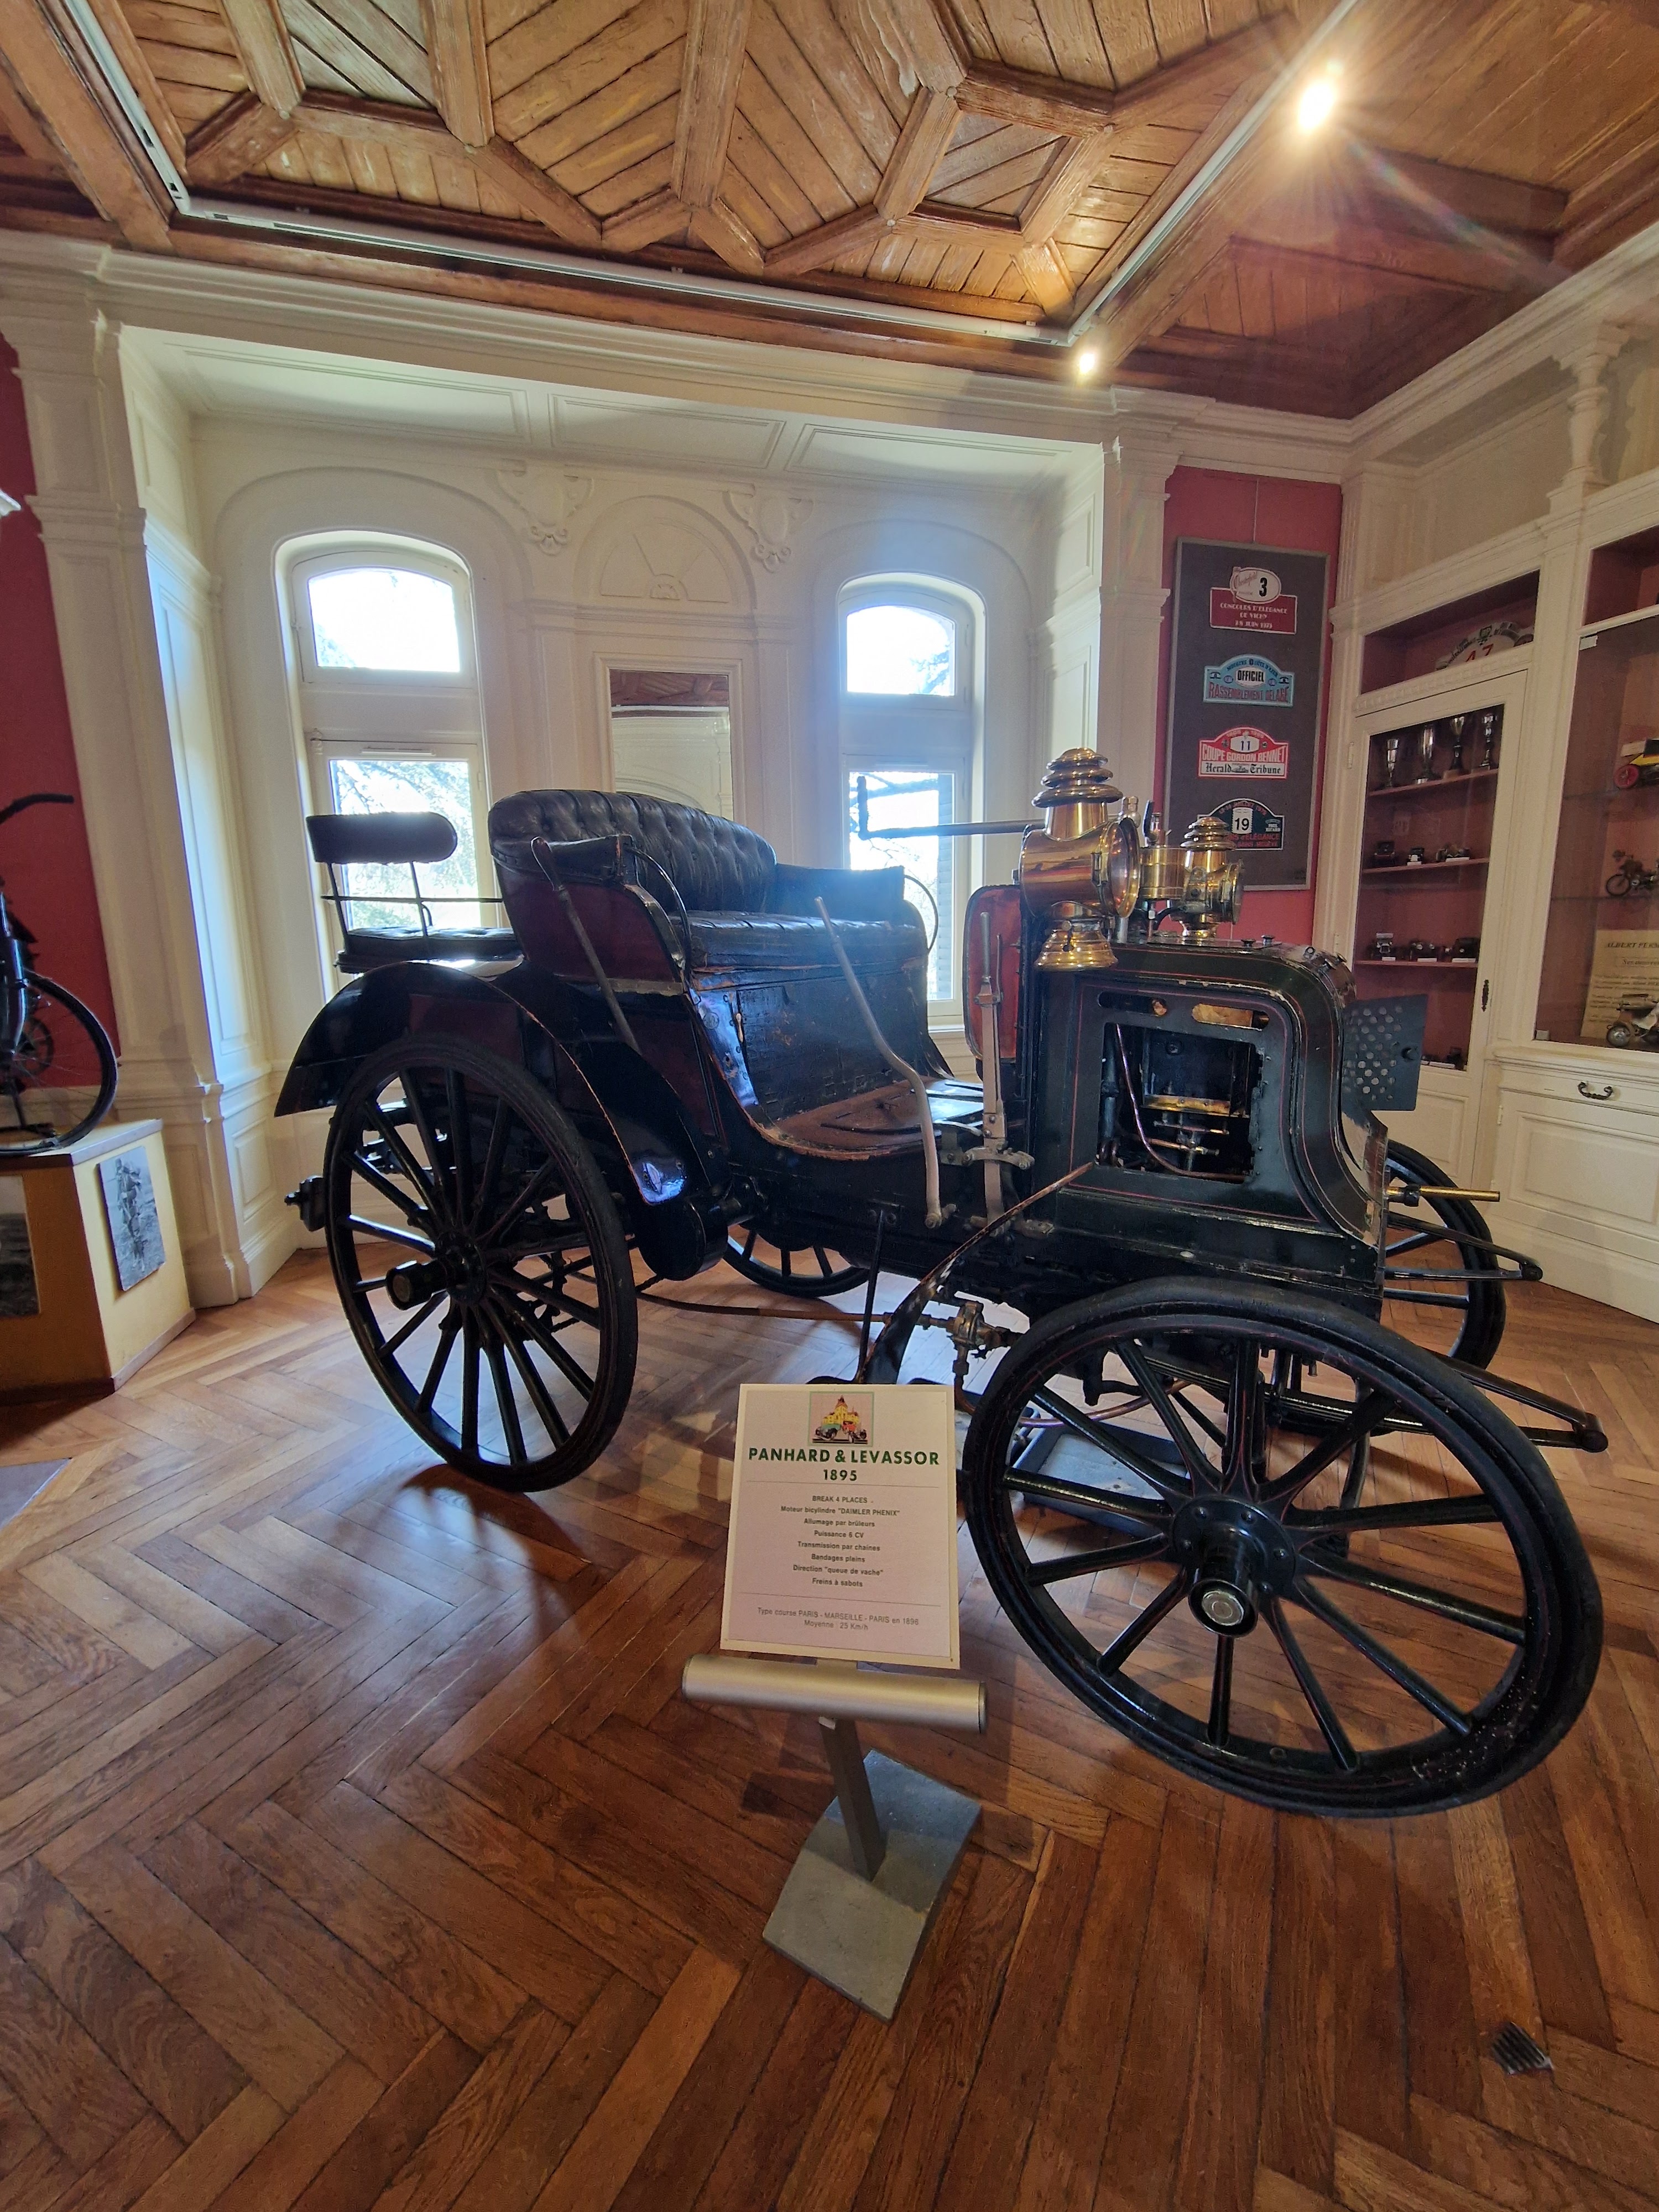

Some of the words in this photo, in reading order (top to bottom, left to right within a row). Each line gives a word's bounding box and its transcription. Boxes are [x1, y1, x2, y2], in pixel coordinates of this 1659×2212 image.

[1259, 577, 1267, 597] 3
[1220, 603, 1251, 611] CONCOURS
[1238, 670, 1264, 682] OFFICIEL
[1241, 740, 1250, 750] 11
[1202, 744, 1226, 761] COUPE
[1227, 752, 1256, 761] GORDON
[1258, 745, 1286, 762] BENNET
[1206, 763, 1232, 773] Herald
[1250, 764, 1281, 774] Tribune
[1234, 818, 1249, 831] 19
[748, 1447, 829, 1463] PANHARD
[834, 1449, 846, 1463] &
[851, 1450, 940, 1465] LEVASSOR
[823, 1469, 857, 1481] 1895
[804, 1518, 833, 1526] Allumage
[798, 1541, 840, 1549] Transmission
[811, 1553, 843, 1562] Bandages
[757, 1607, 773, 1615] Type
[824, 1612, 863, 1621] MARSEILLE
[804, 1619, 834, 1628] Moyenne
